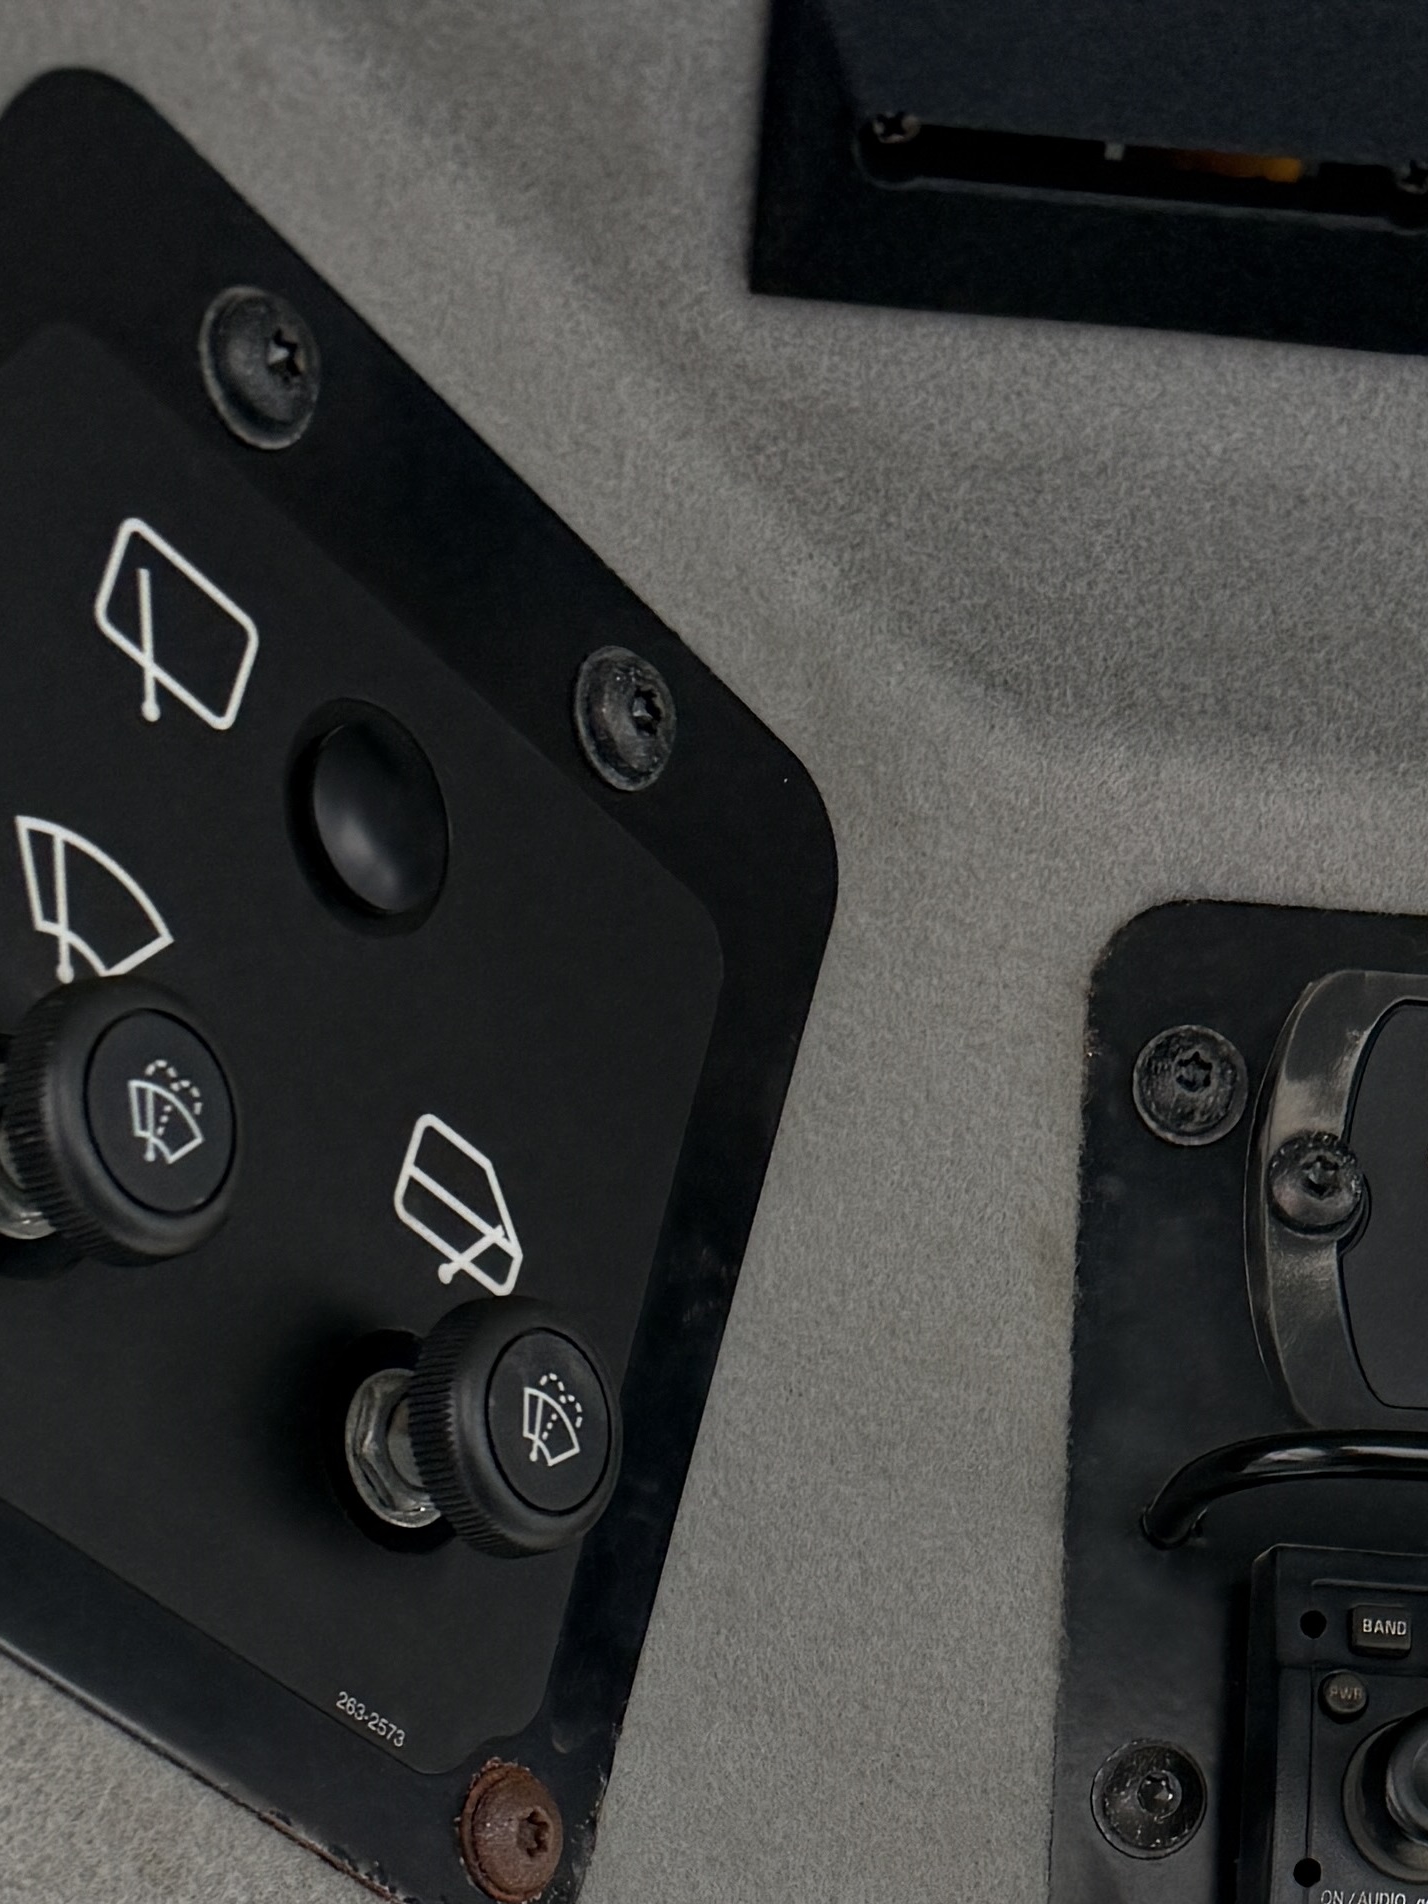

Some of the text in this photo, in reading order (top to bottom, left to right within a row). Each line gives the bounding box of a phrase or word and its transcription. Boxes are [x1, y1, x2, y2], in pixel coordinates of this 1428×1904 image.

[1362, 1618, 1408, 1636] BAND
[1329, 1685, 1363, 1701] PWR
[335, 1691, 406, 1748] 263-2573
